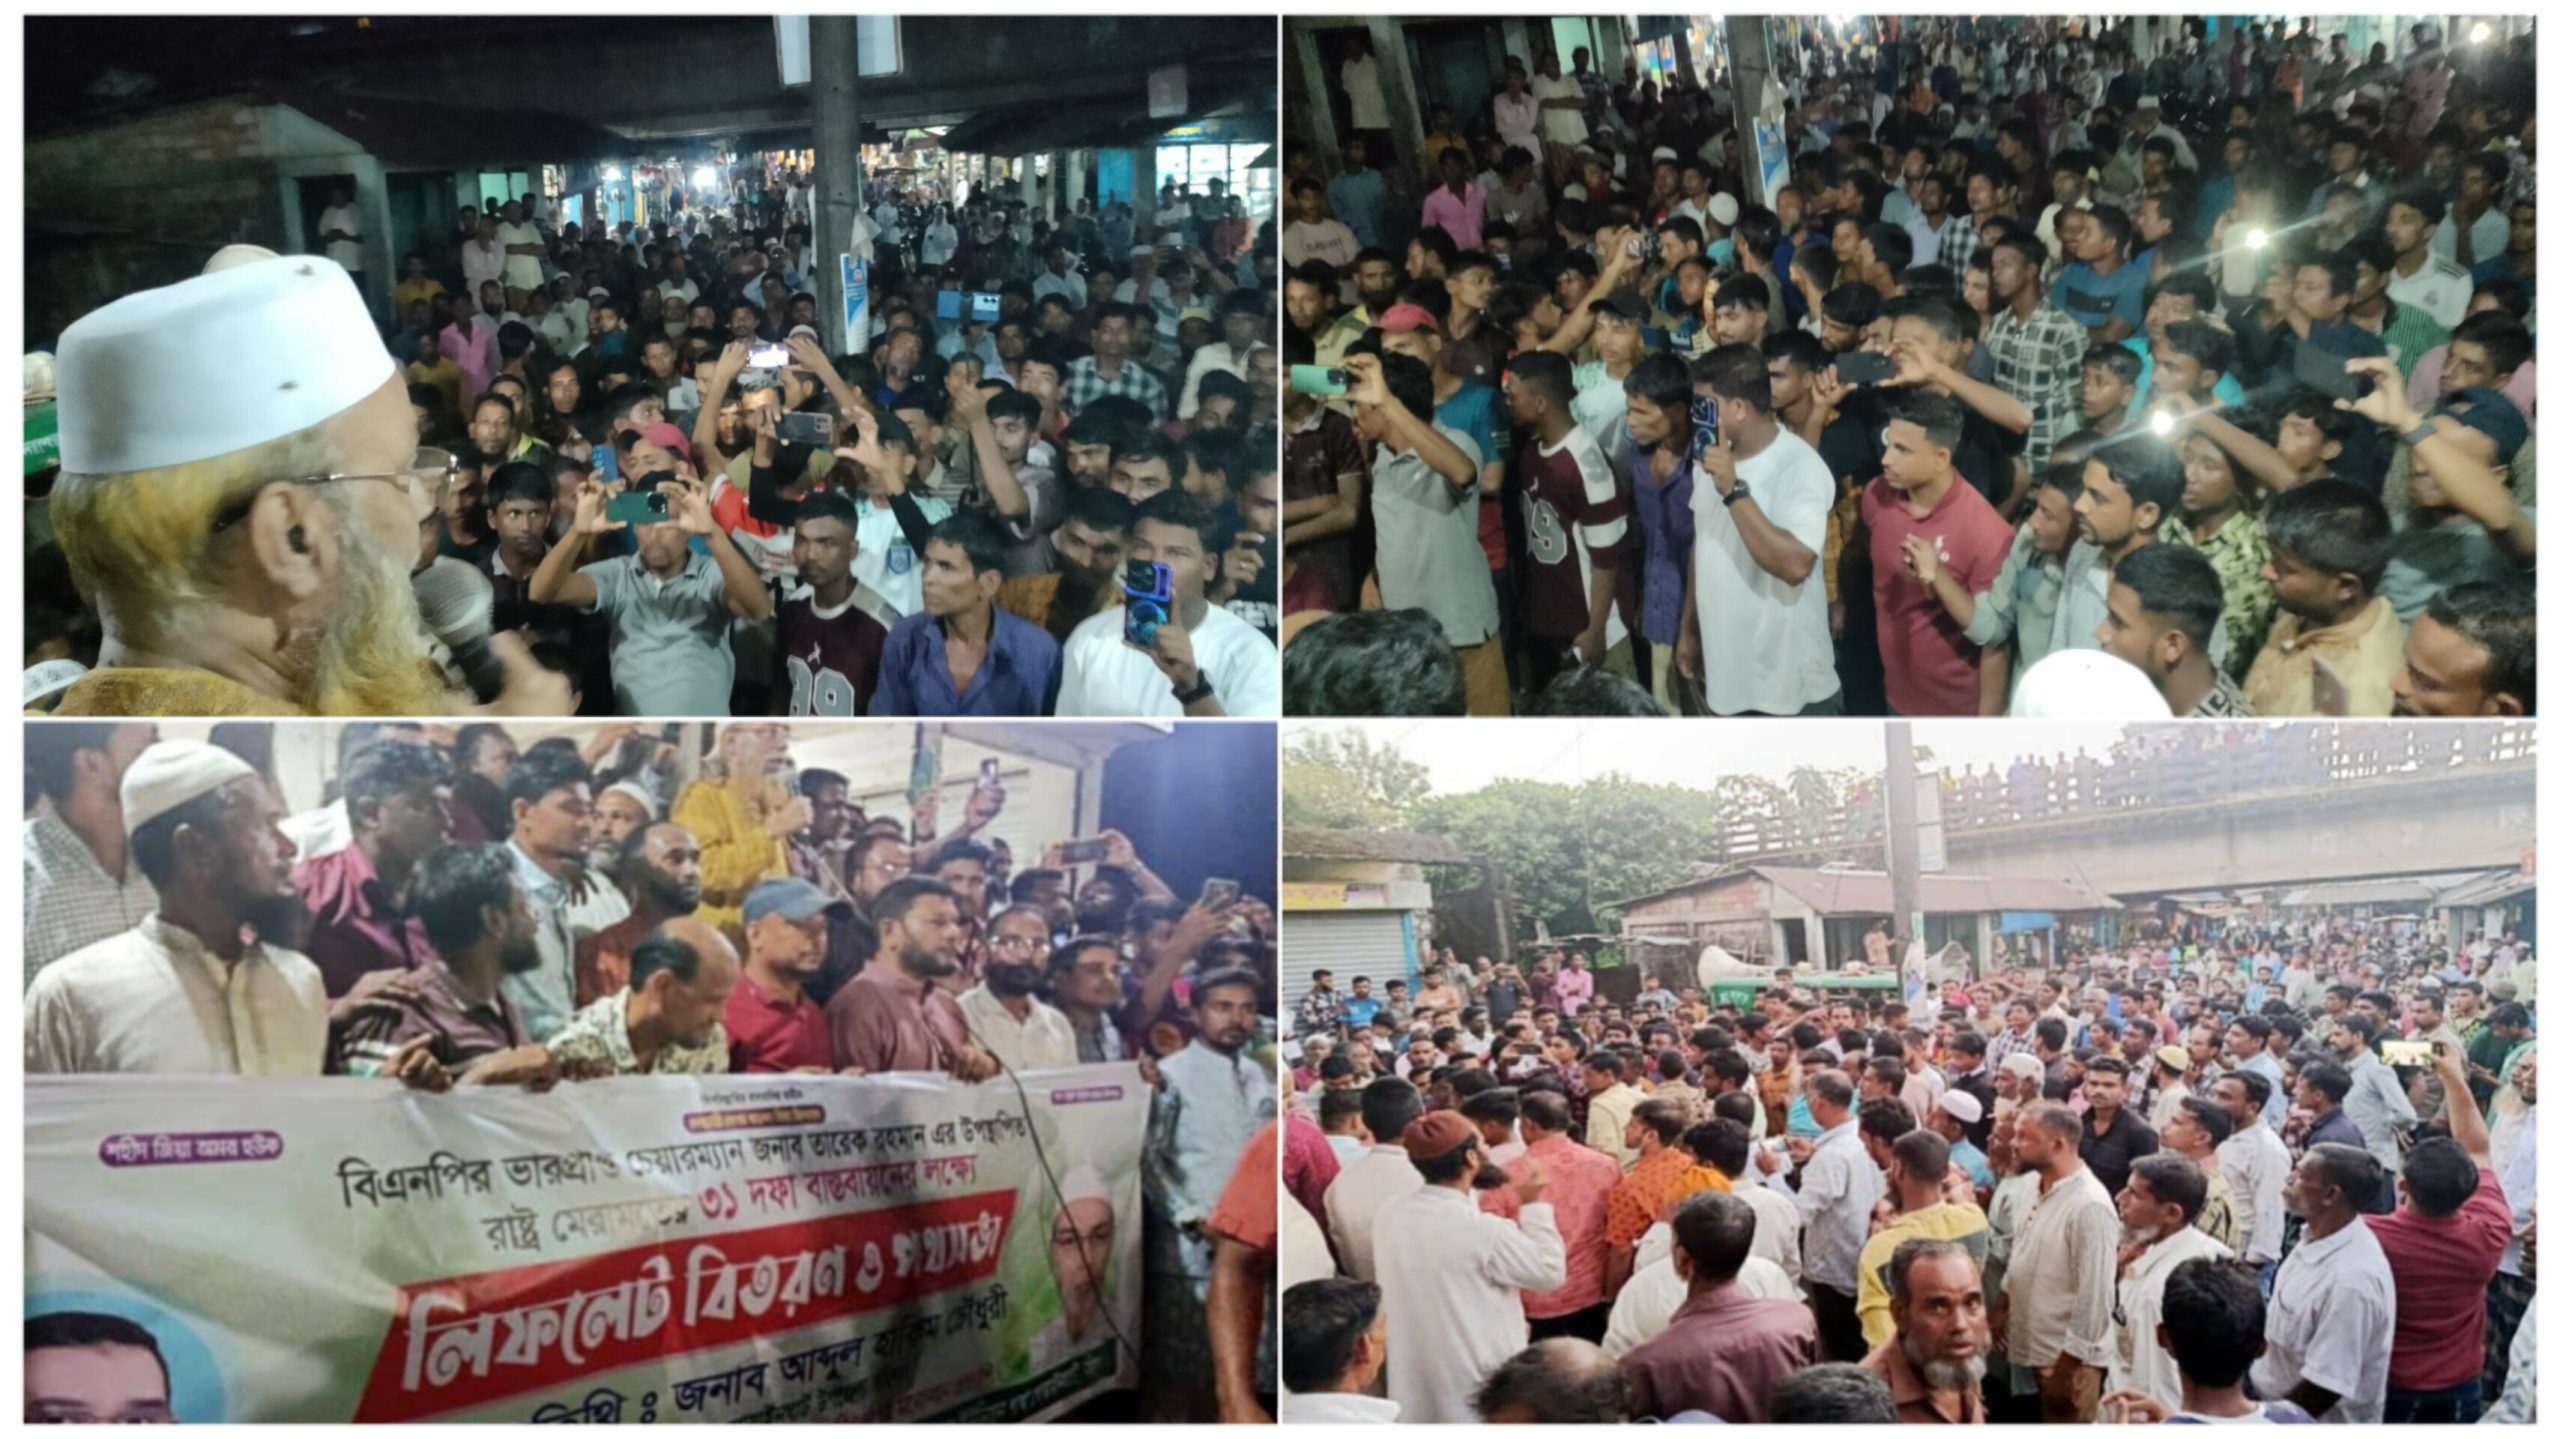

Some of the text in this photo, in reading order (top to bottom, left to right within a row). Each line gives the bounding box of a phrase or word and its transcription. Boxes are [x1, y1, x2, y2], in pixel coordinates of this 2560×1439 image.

[336, 1150, 493, 1208] বিএনপির
[627, 1139, 744, 1176] চেয়ারম্যান
[750, 1133, 804, 1165] জনাব
[808, 1129, 868, 1158] তারেক
[931, 1120, 955, 1146] এর
[480, 1203, 541, 1252] রাষ্ট্র
[698, 1181, 739, 1221] ৩১
[745, 1173, 798, 1213] দফা
[802, 1159, 918, 1206] বাস্তবায়নের
[922, 1154, 978, 1187] লক্ষ্যে
[402, 1254, 674, 1392] লিফলেট
[683, 1243, 848, 1328] বিতরণ
[855, 1240, 885, 1293] ও
[673, 1361, 770, 1413] জনাব
[777, 1337, 866, 1381] আব্দুল
